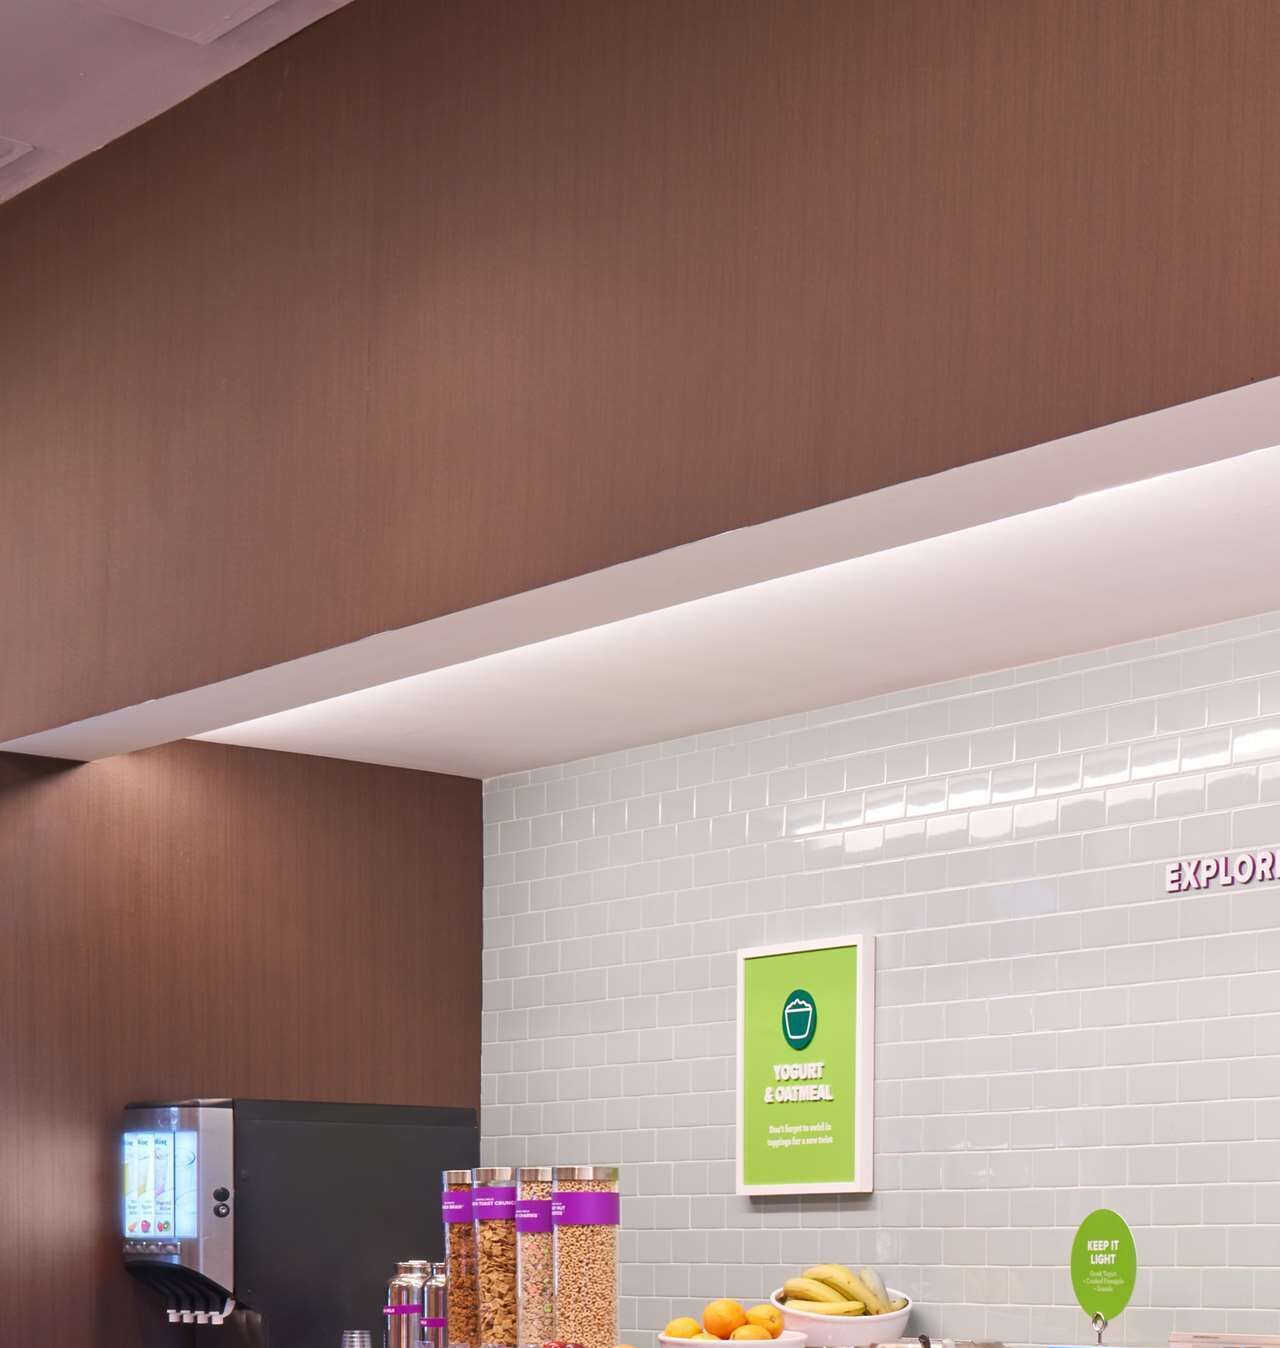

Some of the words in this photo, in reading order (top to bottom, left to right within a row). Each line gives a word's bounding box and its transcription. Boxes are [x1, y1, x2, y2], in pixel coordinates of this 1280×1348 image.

[773, 1061, 825, 1081] YOGURT
[775, 1084, 835, 1103] OATMEAL
[1087, 1239, 1109, 1251] KEEP
[1111, 1239, 1120, 1251] IT
[1090, 1253, 1116, 1265] LIGHT
